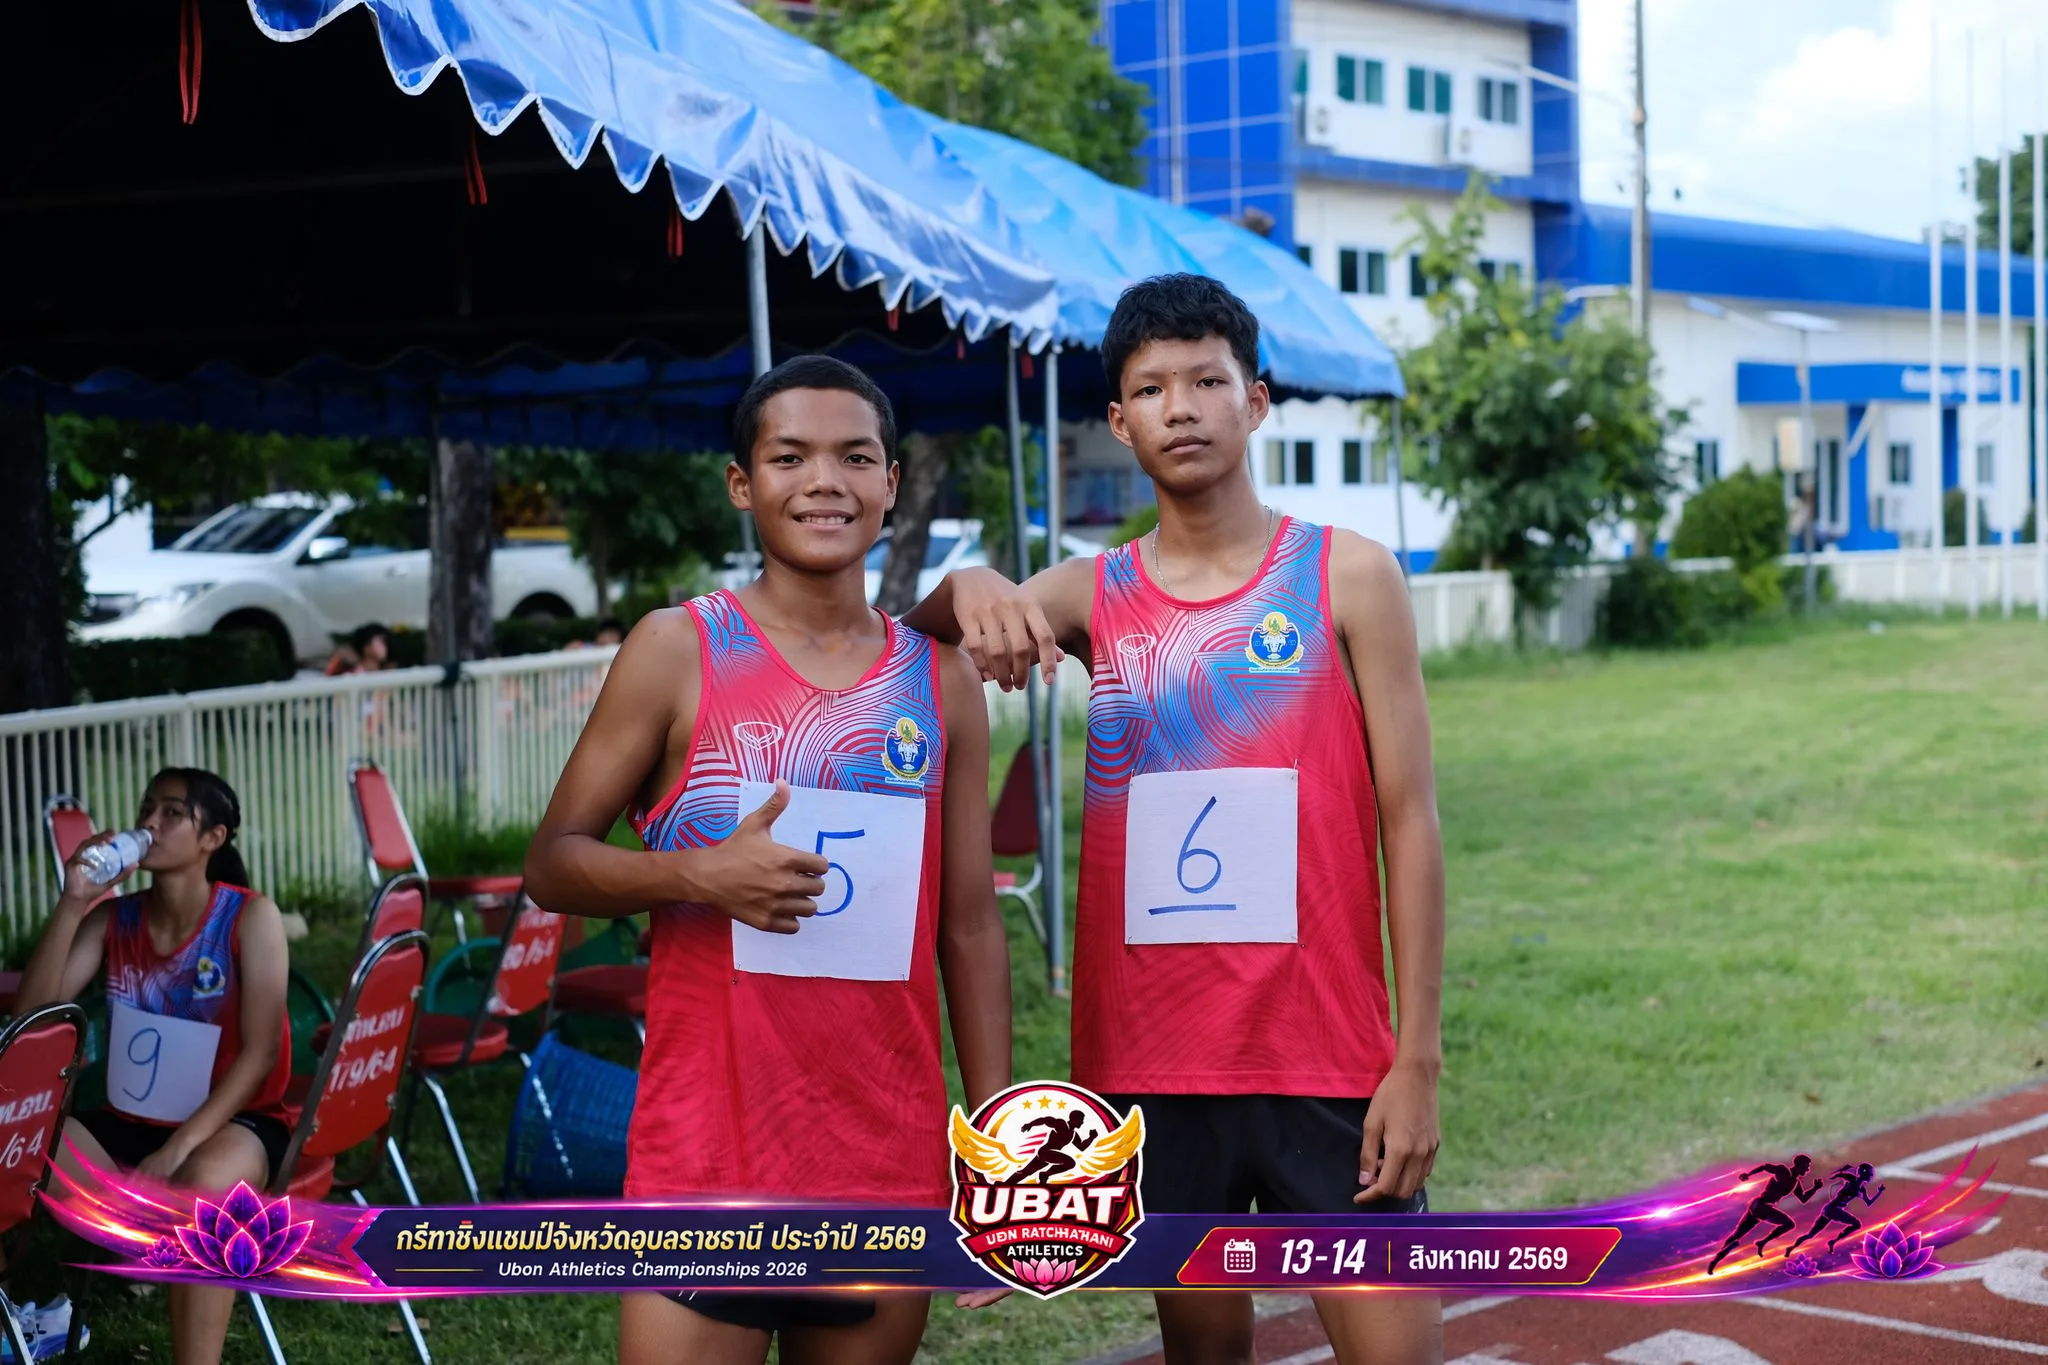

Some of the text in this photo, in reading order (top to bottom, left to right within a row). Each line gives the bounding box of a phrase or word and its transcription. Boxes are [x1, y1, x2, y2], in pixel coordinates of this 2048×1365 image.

[815, 829, 865, 917] 5
[1177, 795, 1222, 894] 6
[123, 1028, 161, 1102] 9
